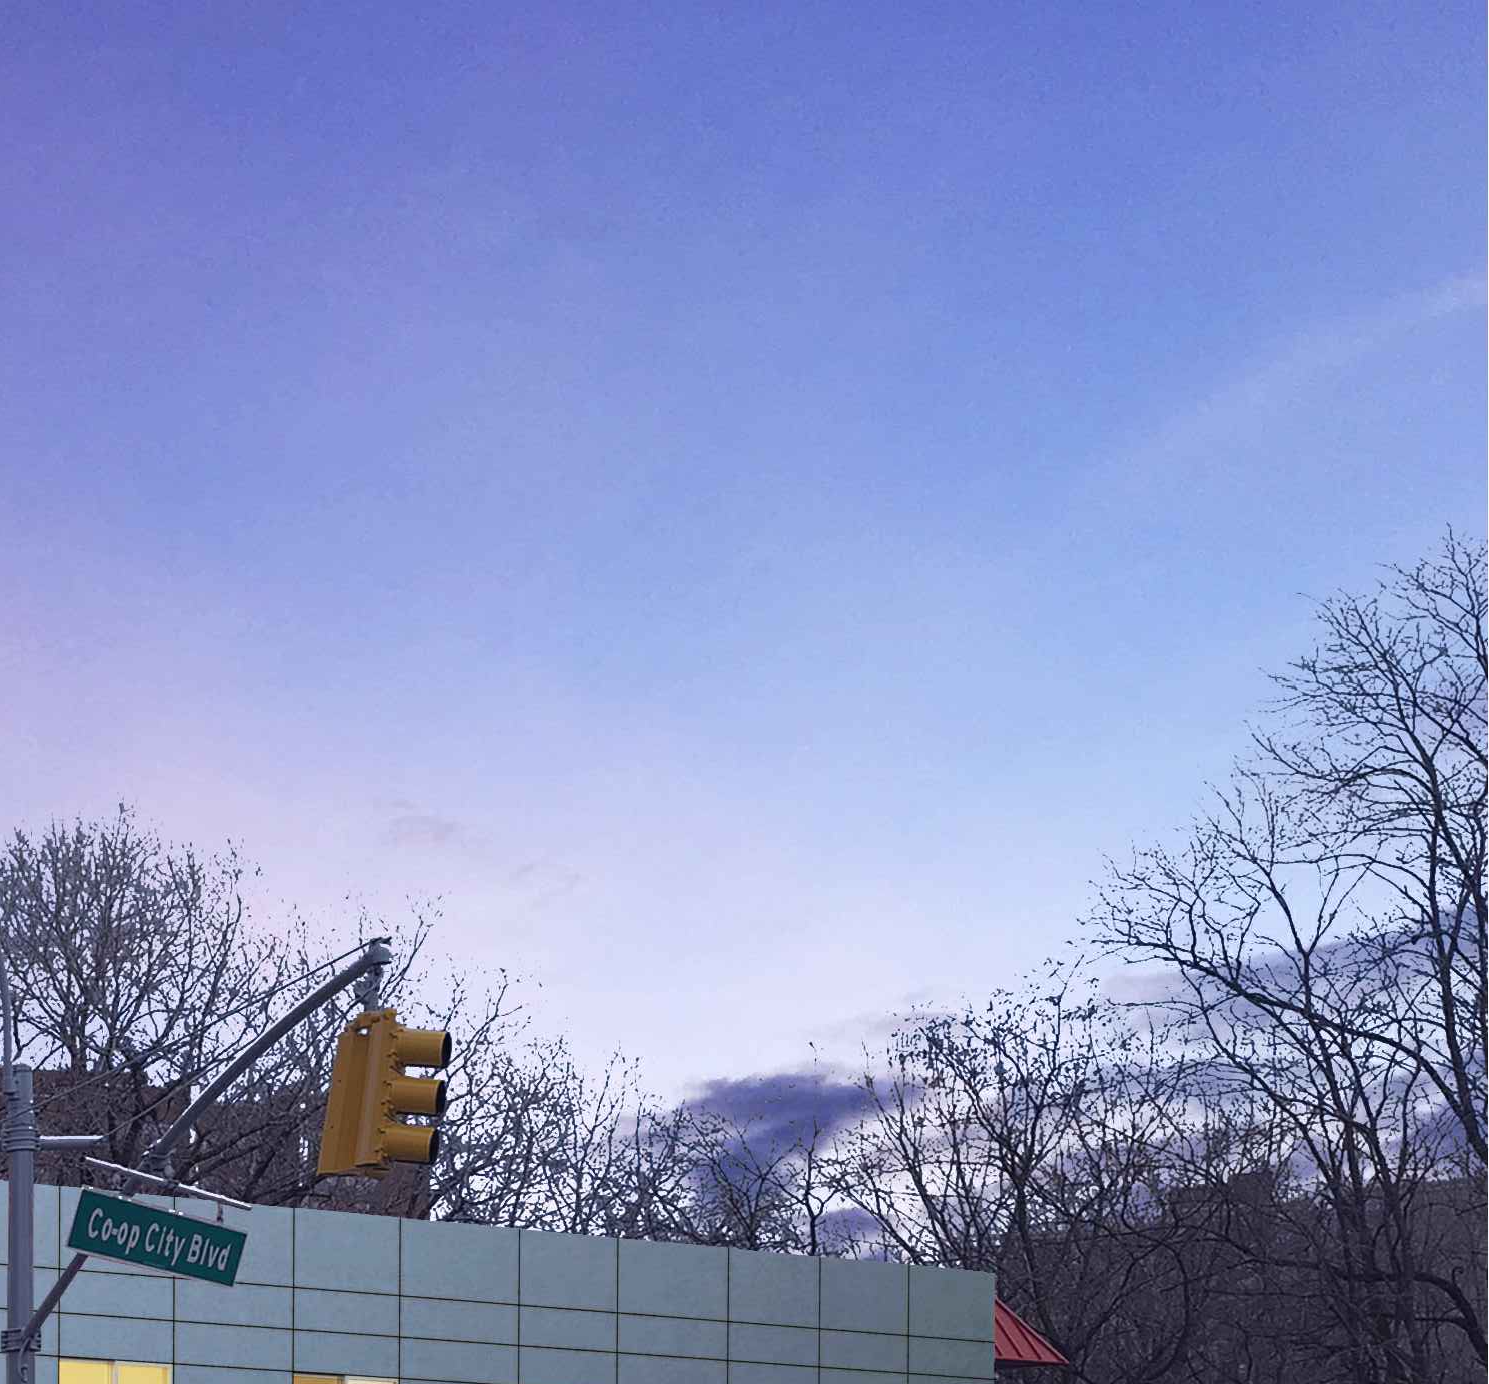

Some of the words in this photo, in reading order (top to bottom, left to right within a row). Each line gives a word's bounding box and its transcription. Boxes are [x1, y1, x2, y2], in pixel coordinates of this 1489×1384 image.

[88, 1207, 140, 1255] Co-op
[145, 1222, 185, 1266] City
[187, 1233, 231, 1271] Blvd
